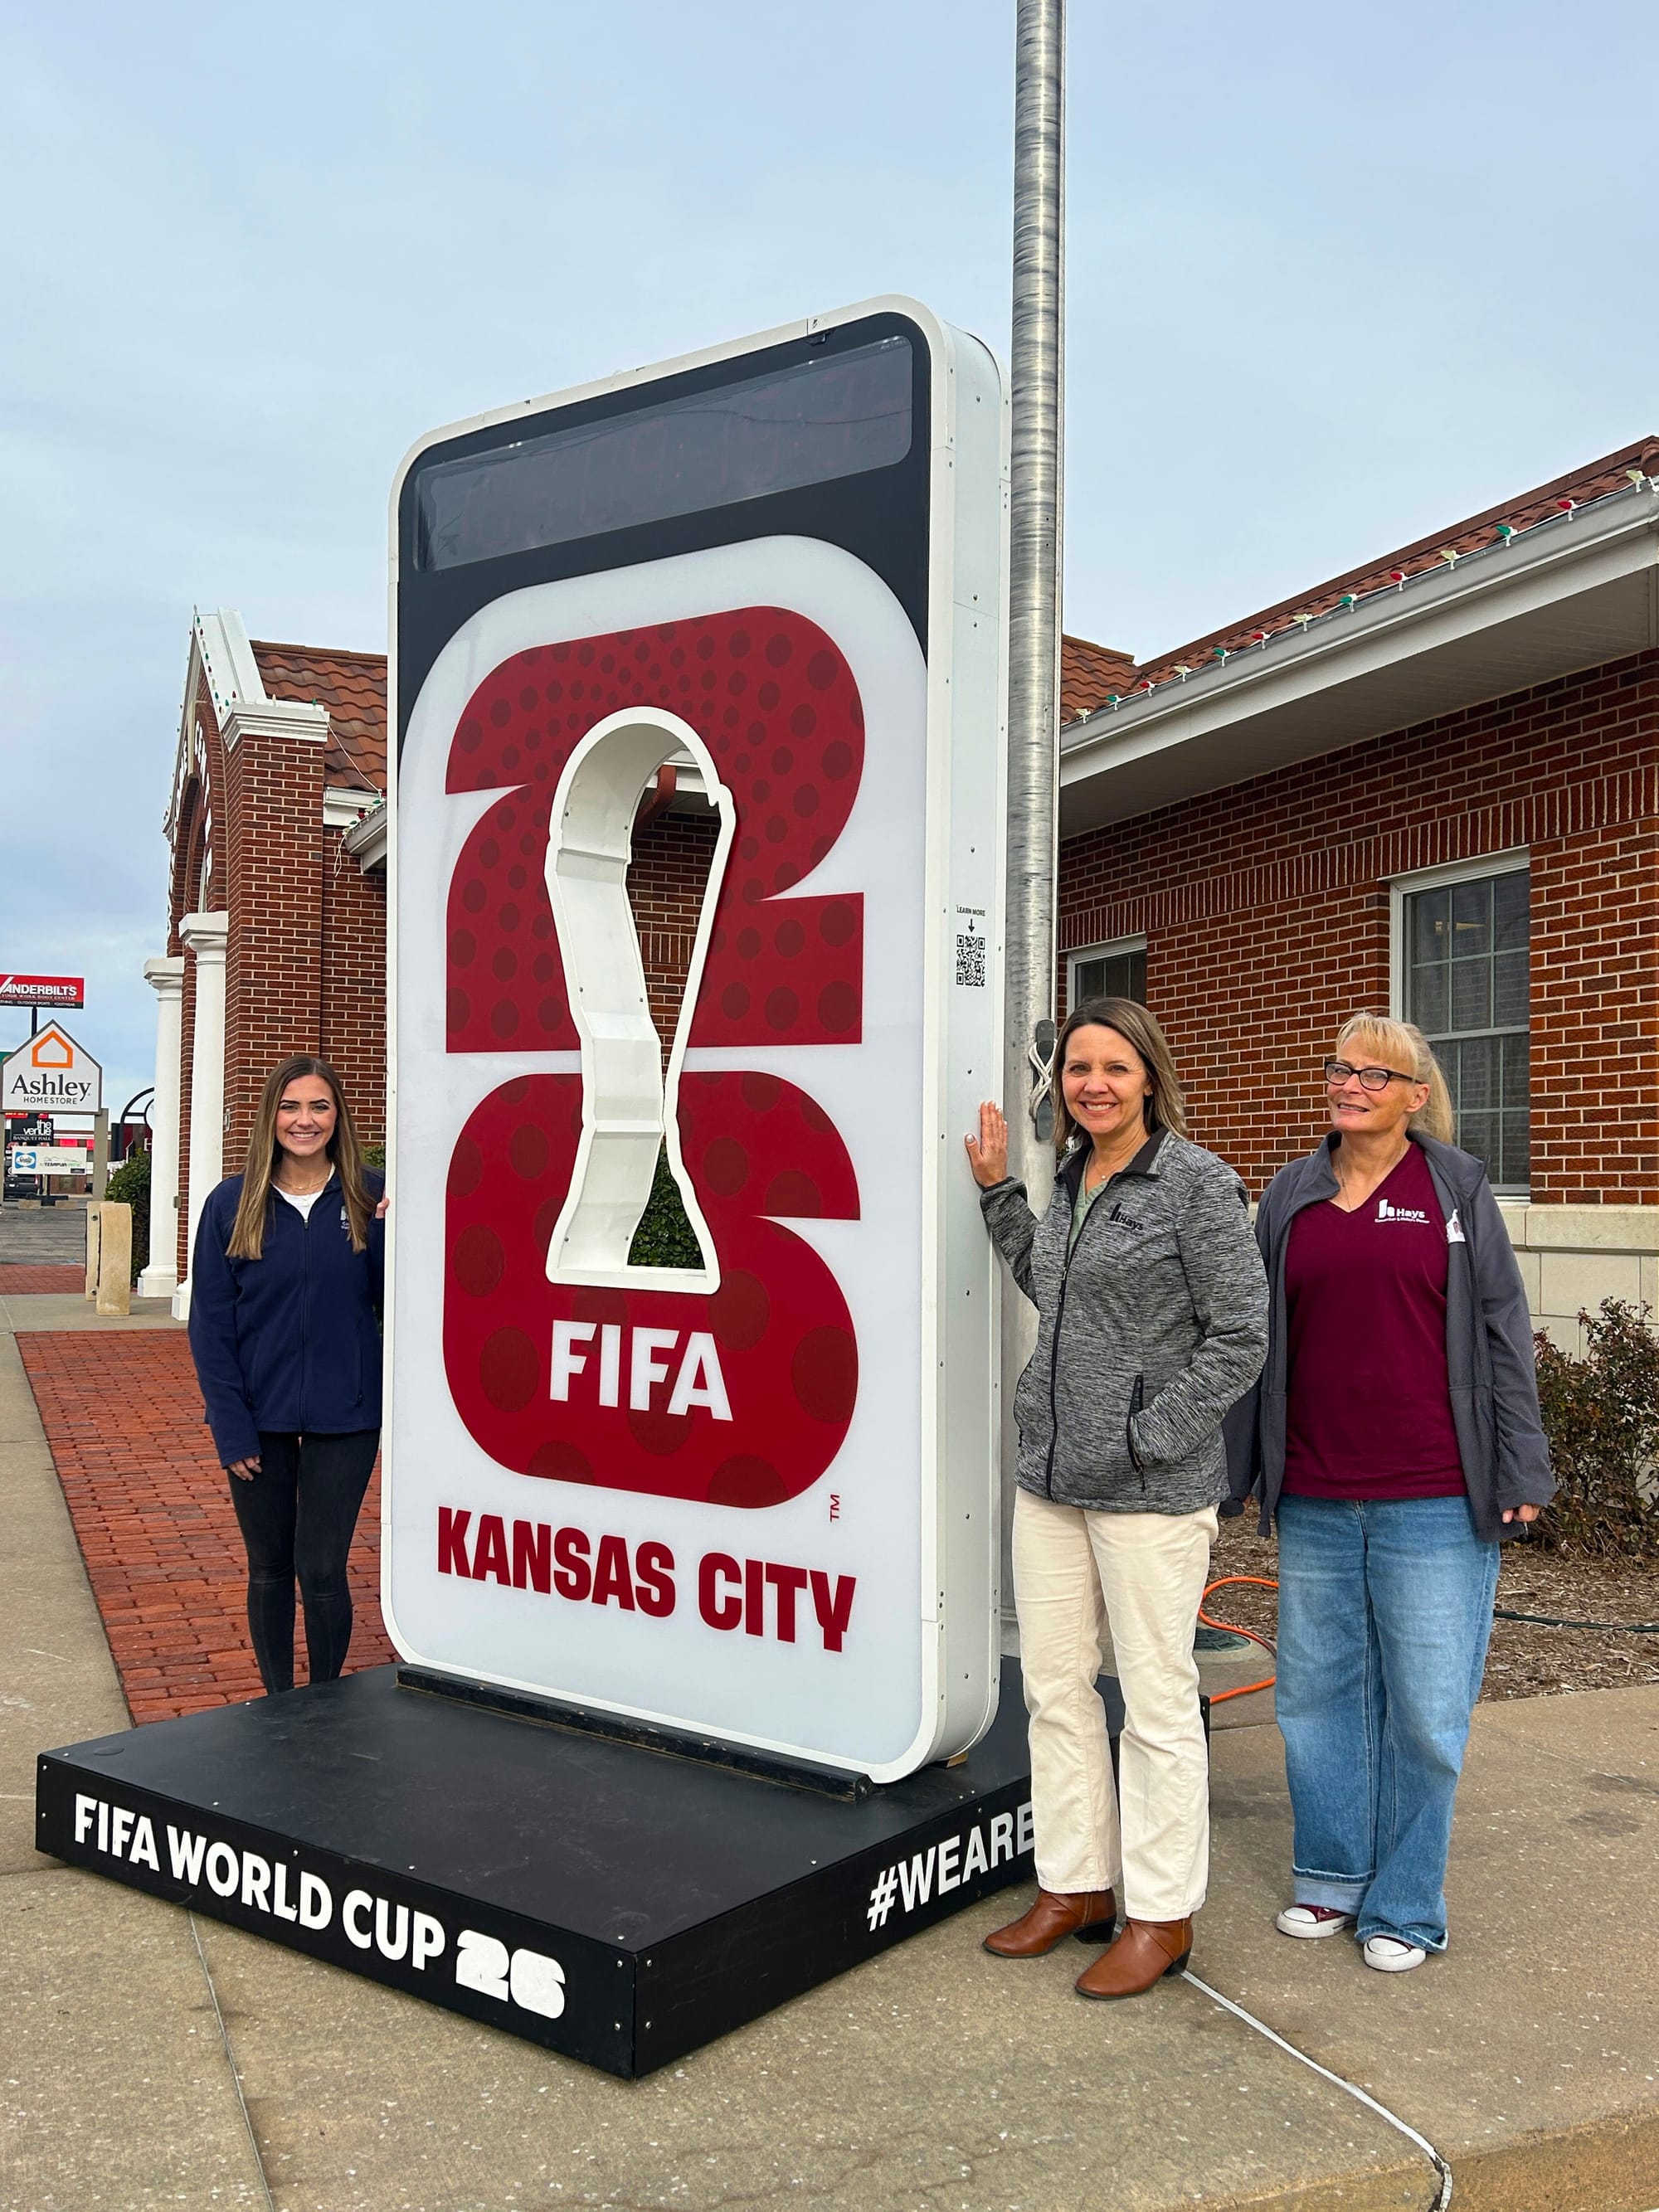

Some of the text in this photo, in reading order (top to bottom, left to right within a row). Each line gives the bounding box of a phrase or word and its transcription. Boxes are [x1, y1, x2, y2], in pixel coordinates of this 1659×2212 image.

[956, 905, 972, 914] LEARN
[10, 1073, 91, 1101] Ashley
[23, 1096, 78, 1105] HOMESTORE
[23, 1127, 51, 1135] venue
[36, 1119, 51, 1128] the
[1396, 1208, 1426, 1219] Hays
[1119, 1214, 1144, 1231] Hays
[550, 1320, 733, 1421] FIFA
[830, 1494, 839, 1523] TM
[438, 1506, 857, 1653] KANSAS CITY
[74, 1793, 567, 2020] FIFA WORLD CUP 26
